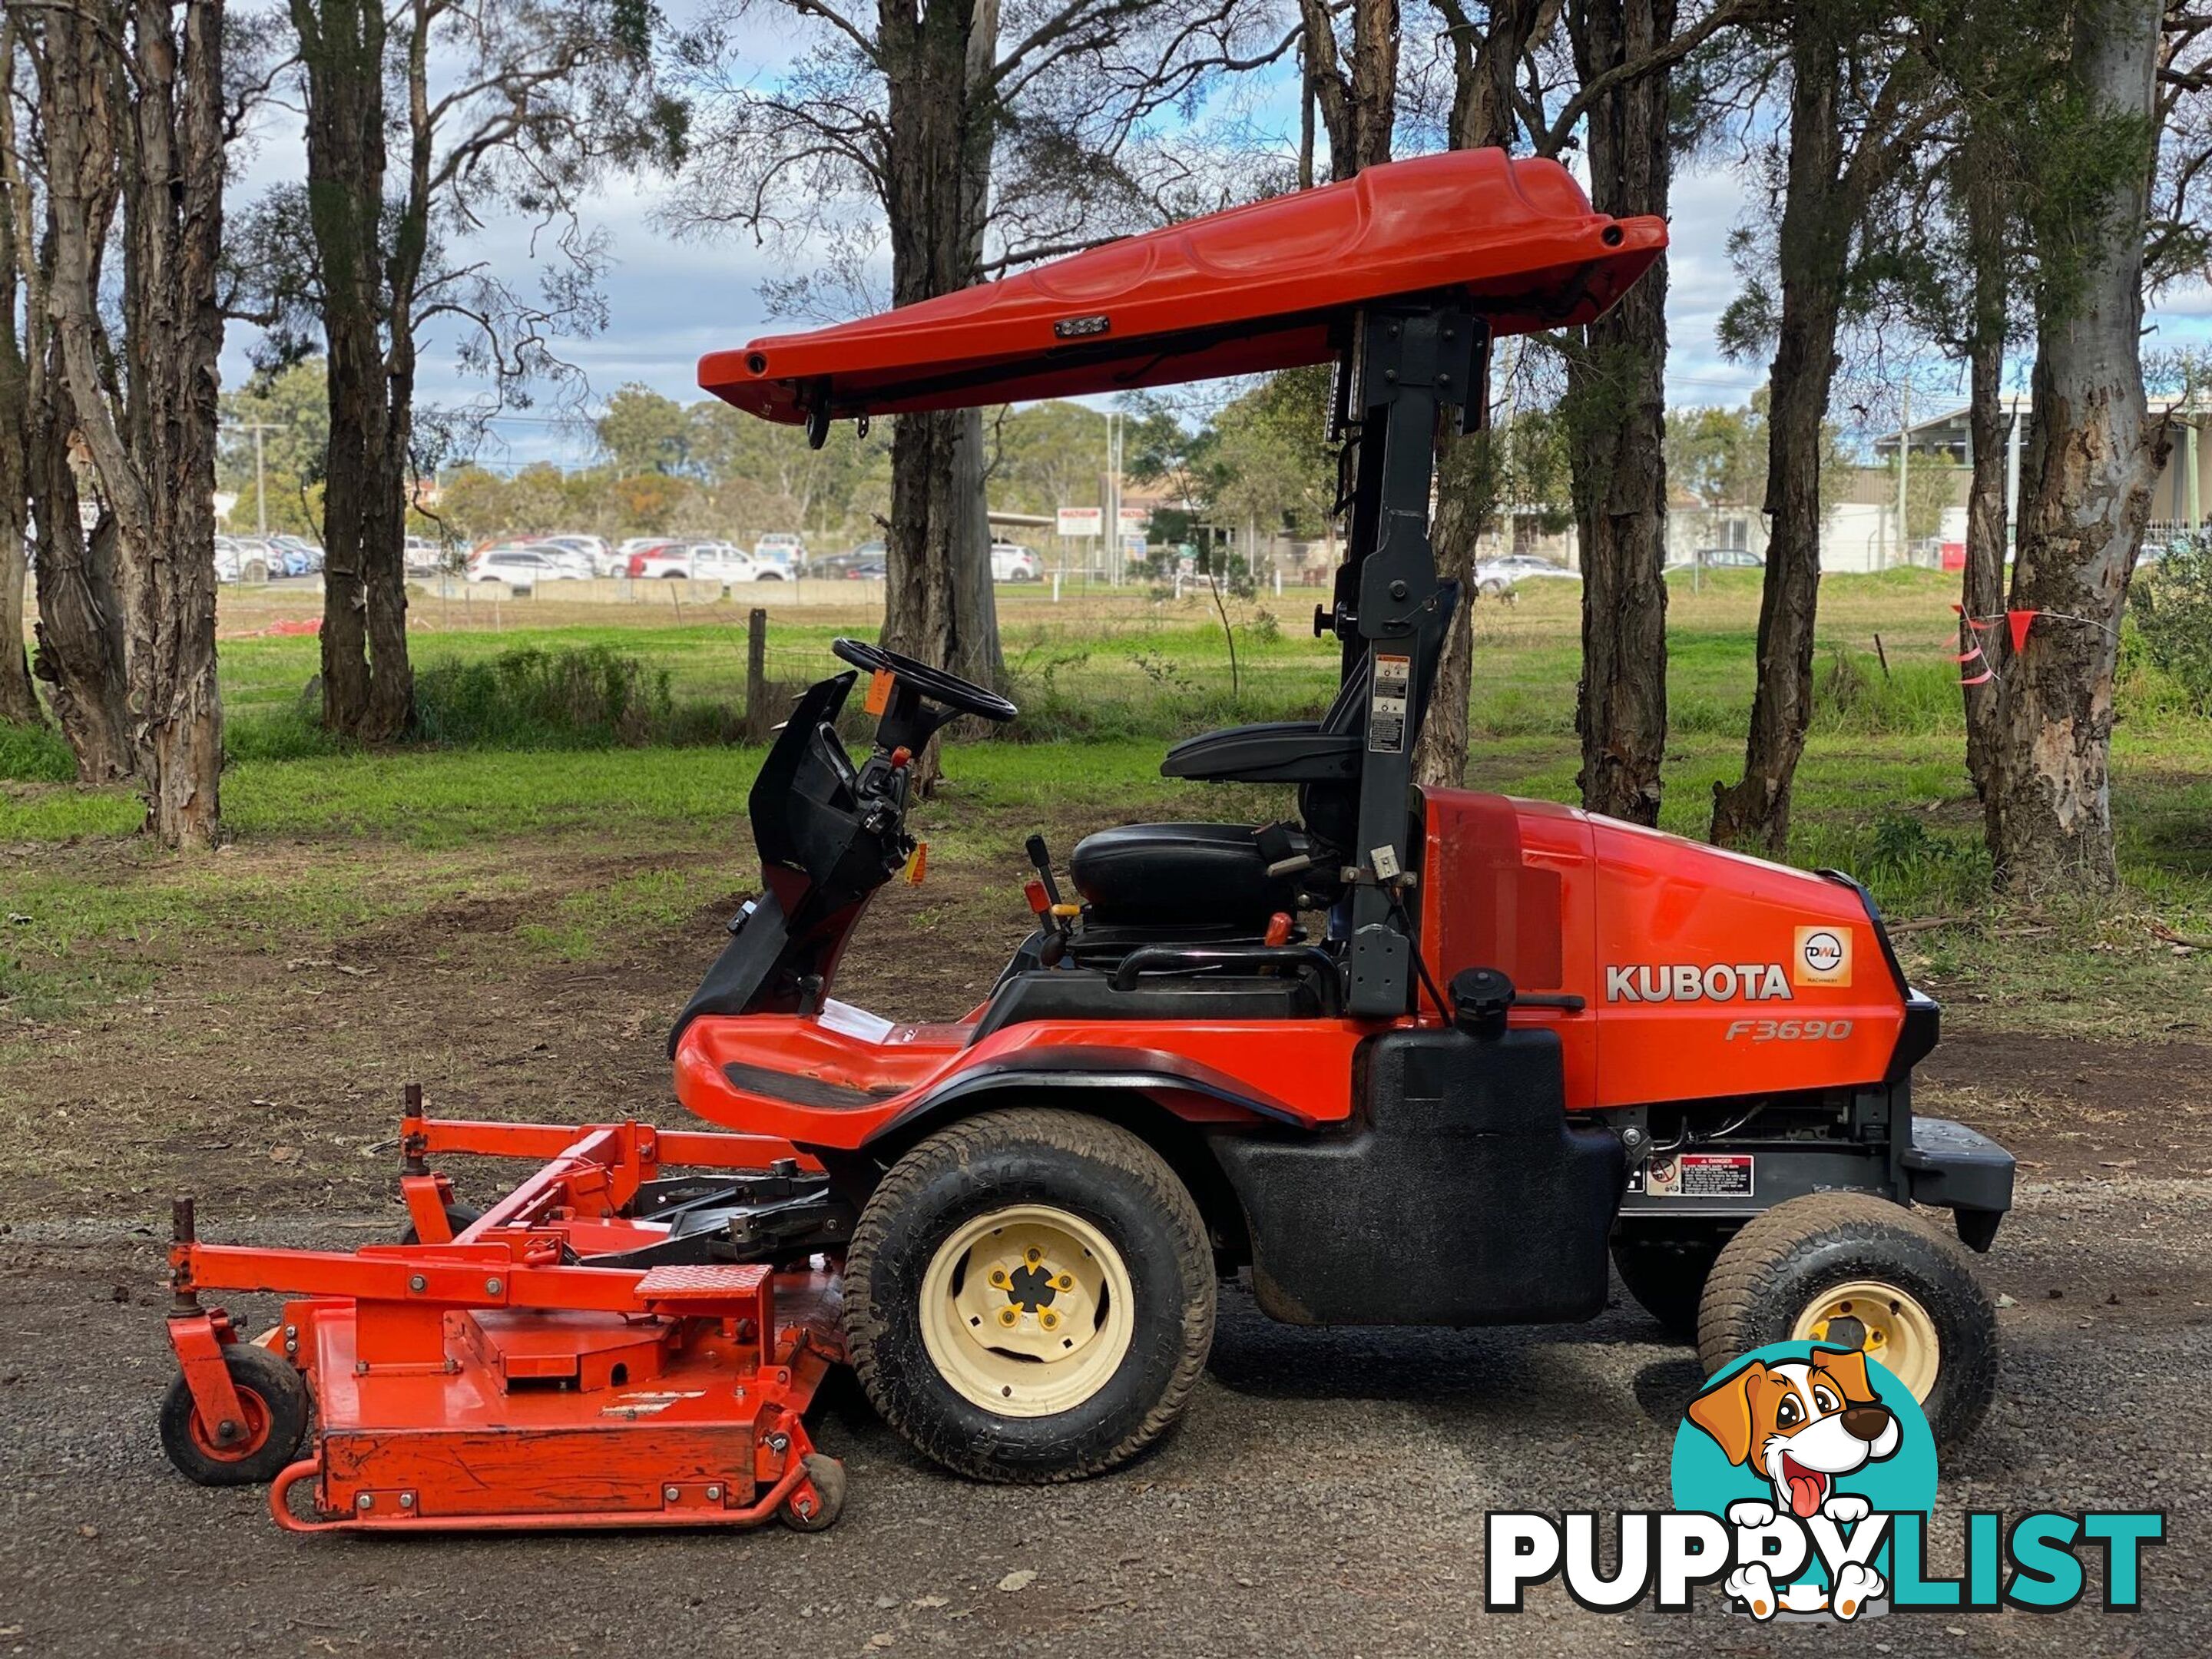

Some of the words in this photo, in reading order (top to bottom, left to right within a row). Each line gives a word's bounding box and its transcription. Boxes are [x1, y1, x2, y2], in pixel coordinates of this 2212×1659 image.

[1806, 946, 1841, 957] DWL
[1606, 964, 1793, 1002] KUBOTA
[1725, 1020, 1853, 1041] F3690
